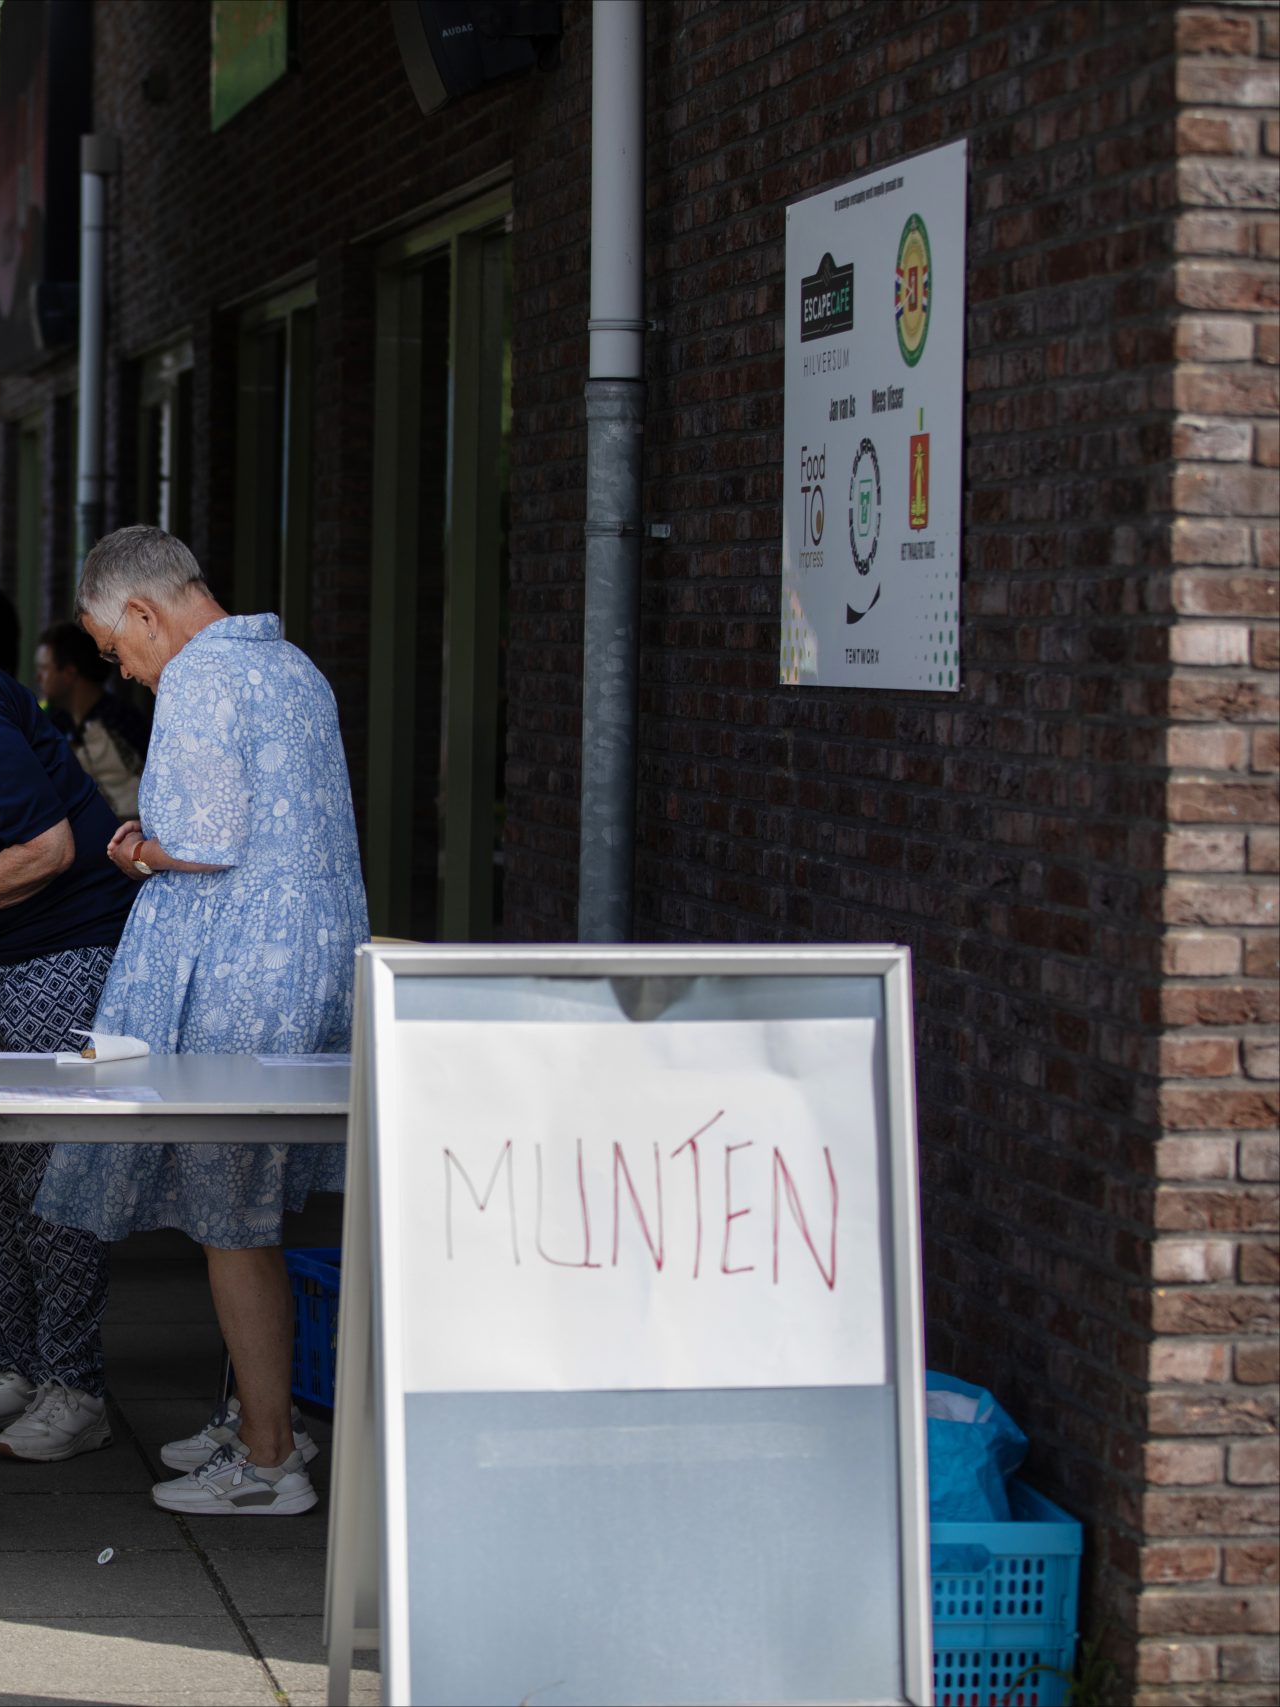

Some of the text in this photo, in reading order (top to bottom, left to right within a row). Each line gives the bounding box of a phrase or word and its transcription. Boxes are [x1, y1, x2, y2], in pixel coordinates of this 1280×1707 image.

[441, 23, 474, 38] AUDAC
[803, 348, 850, 377] HILVERSUM
[872, 388, 886, 414] Mees
[801, 443, 826, 482] Food
[801, 485, 824, 547] TO
[845, 648, 880, 664] TENTWORX
[442, 1109, 840, 1291] MUNTEN
